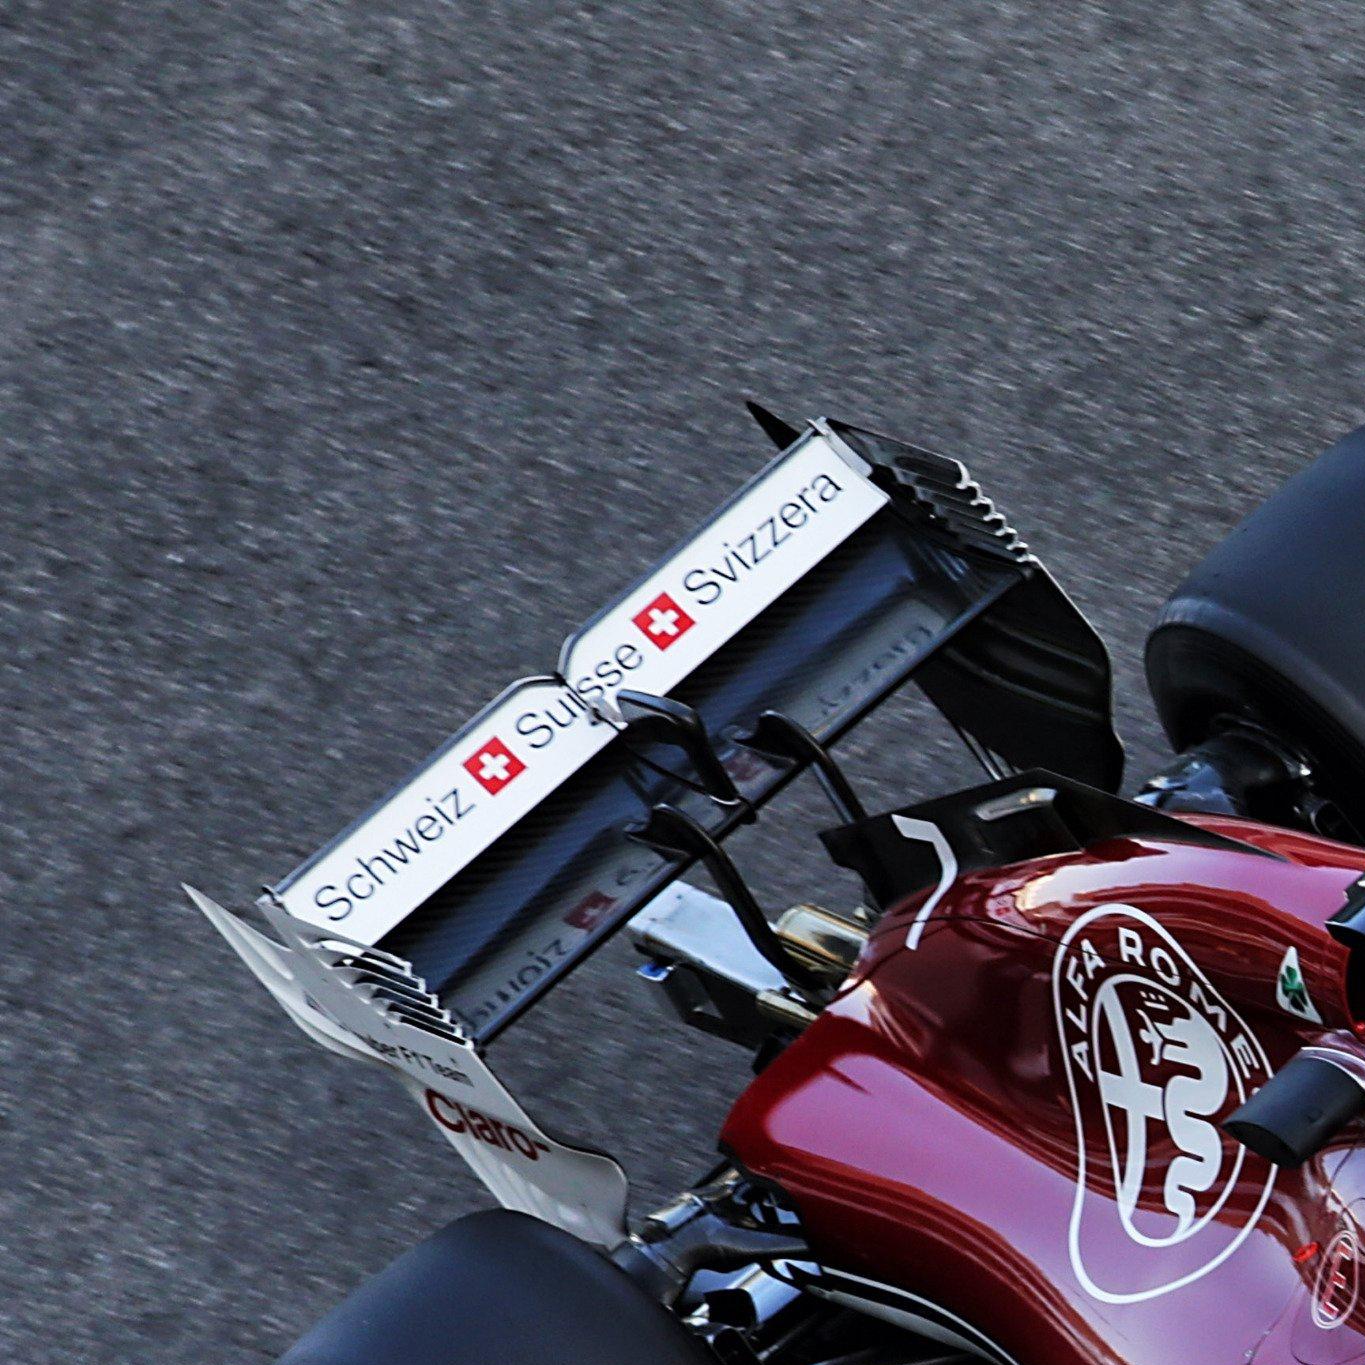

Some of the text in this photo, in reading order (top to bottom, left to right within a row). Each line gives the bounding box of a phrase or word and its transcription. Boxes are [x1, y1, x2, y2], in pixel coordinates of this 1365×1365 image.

[314, 471, 843, 921] Schweiz Suisse Svizzera
[1066, 926, 1261, 1096] ALFA ROME
[424, 1088, 541, 1163] Claro
